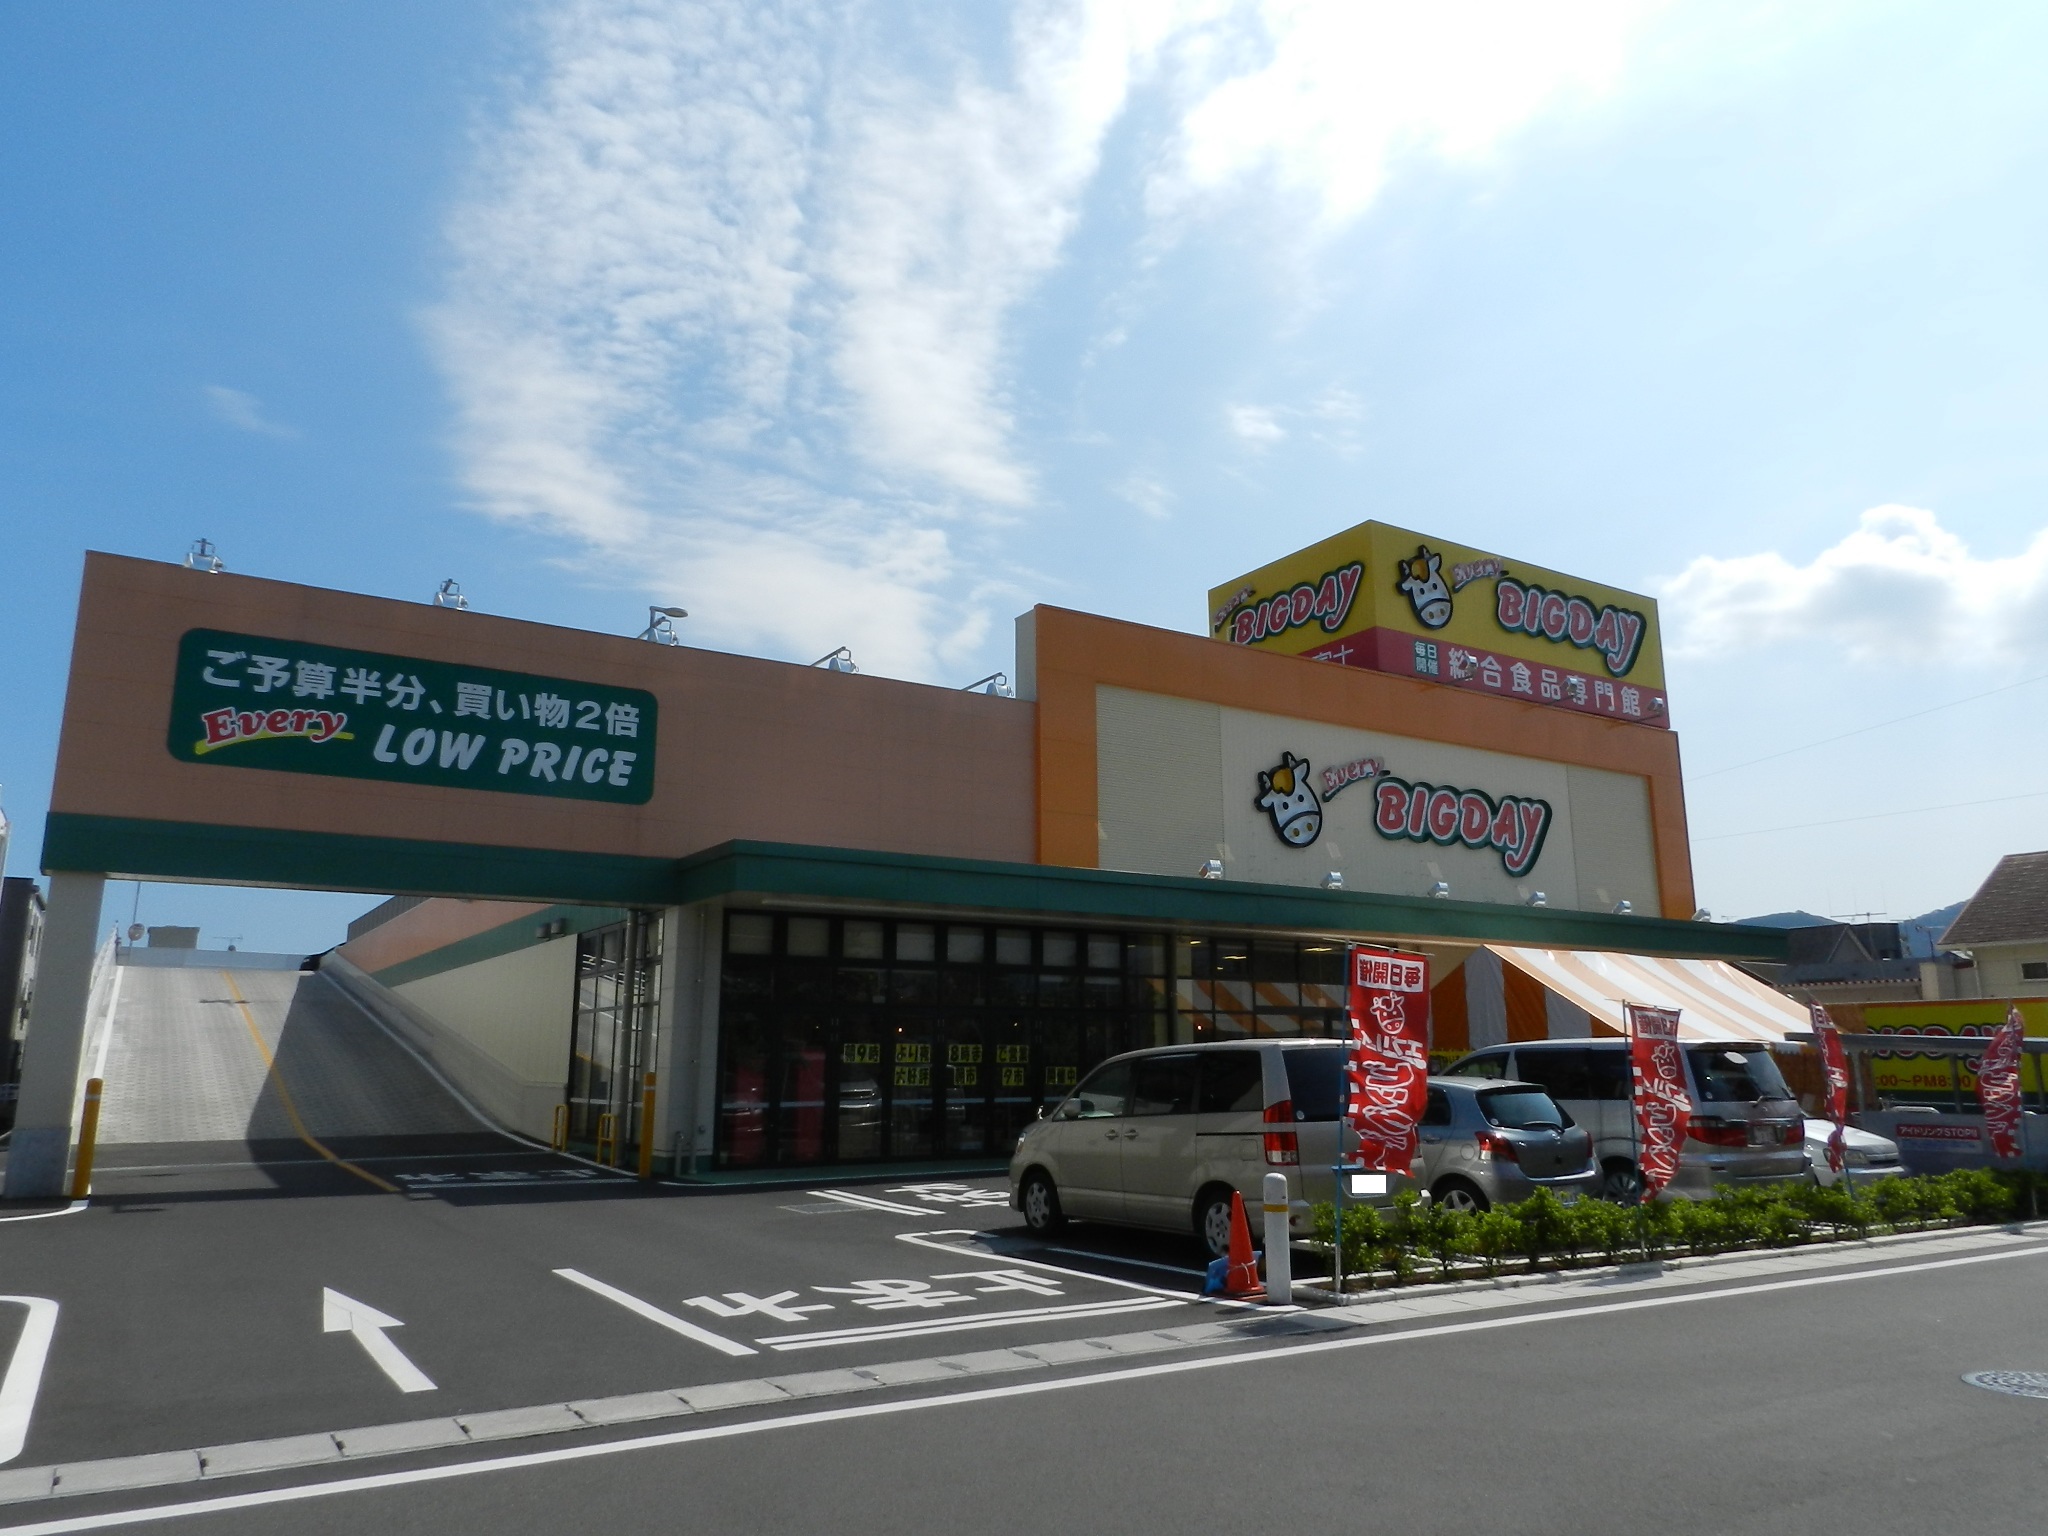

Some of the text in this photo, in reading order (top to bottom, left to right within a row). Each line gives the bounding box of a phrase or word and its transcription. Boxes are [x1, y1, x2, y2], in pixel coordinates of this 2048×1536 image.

[1231, 561, 1364, 645] BIGDAY
[1449, 557, 1505, 590] Every
[1496, 577, 1647, 678] BIGDAY
[201, 706, 638, 787] Every LOW PRICE
[1321, 755, 1387, 797] Every
[1373, 776, 1553, 877] BIGDAY
[682, 1269, 1065, 1322] 止まれ
